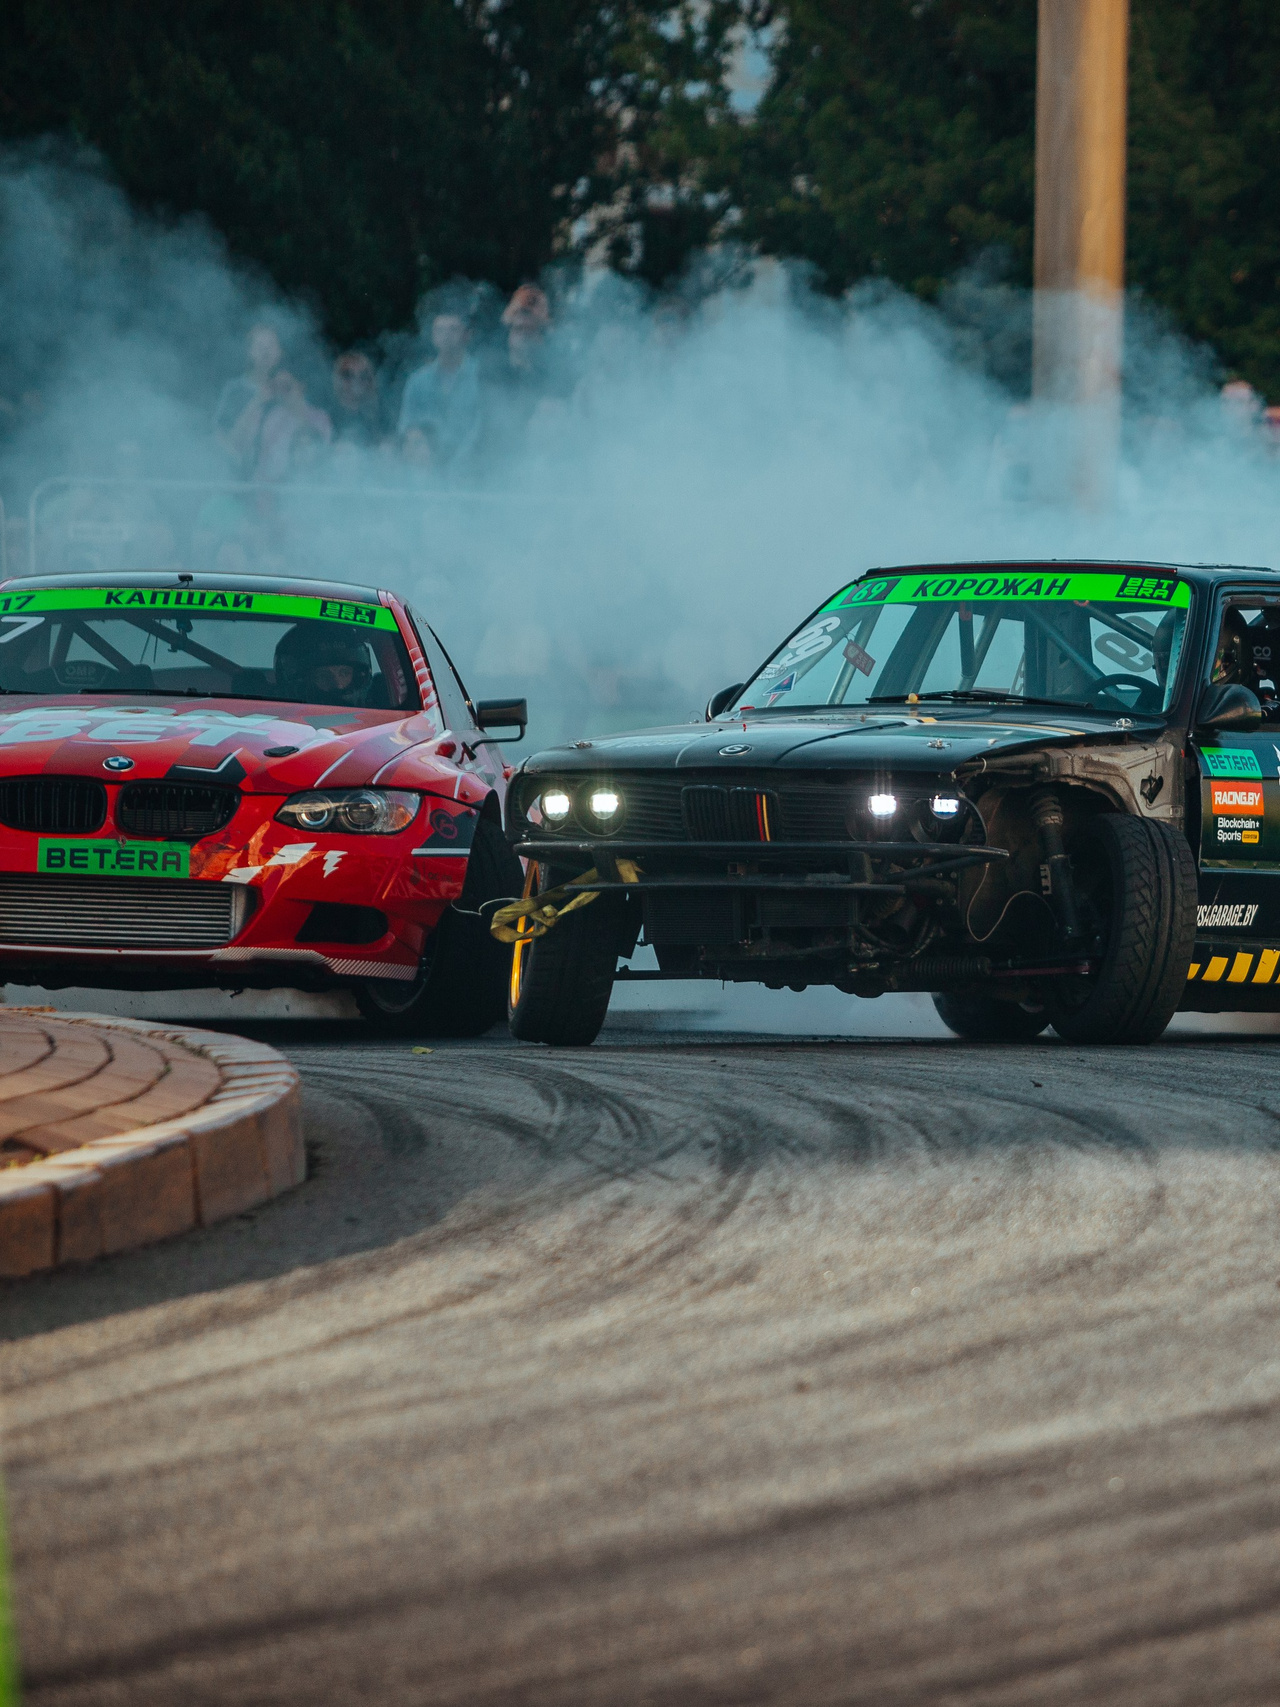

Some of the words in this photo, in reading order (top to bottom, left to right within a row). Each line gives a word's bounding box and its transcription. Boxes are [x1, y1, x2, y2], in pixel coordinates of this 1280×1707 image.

[851, 581, 888, 601] 69
[911, 577, 1072, 598] КОРОЖАН
[1126, 577, 1174, 589] BET
[0, 594, 36, 611] 17
[0, 719, 272, 747] BET
[1207, 754, 1259, 772] BET.ERA
[1217, 817, 1256, 829] Blockchain
[1217, 829, 1242, 843] Sports
[46, 848, 181, 872] BET.ERA
